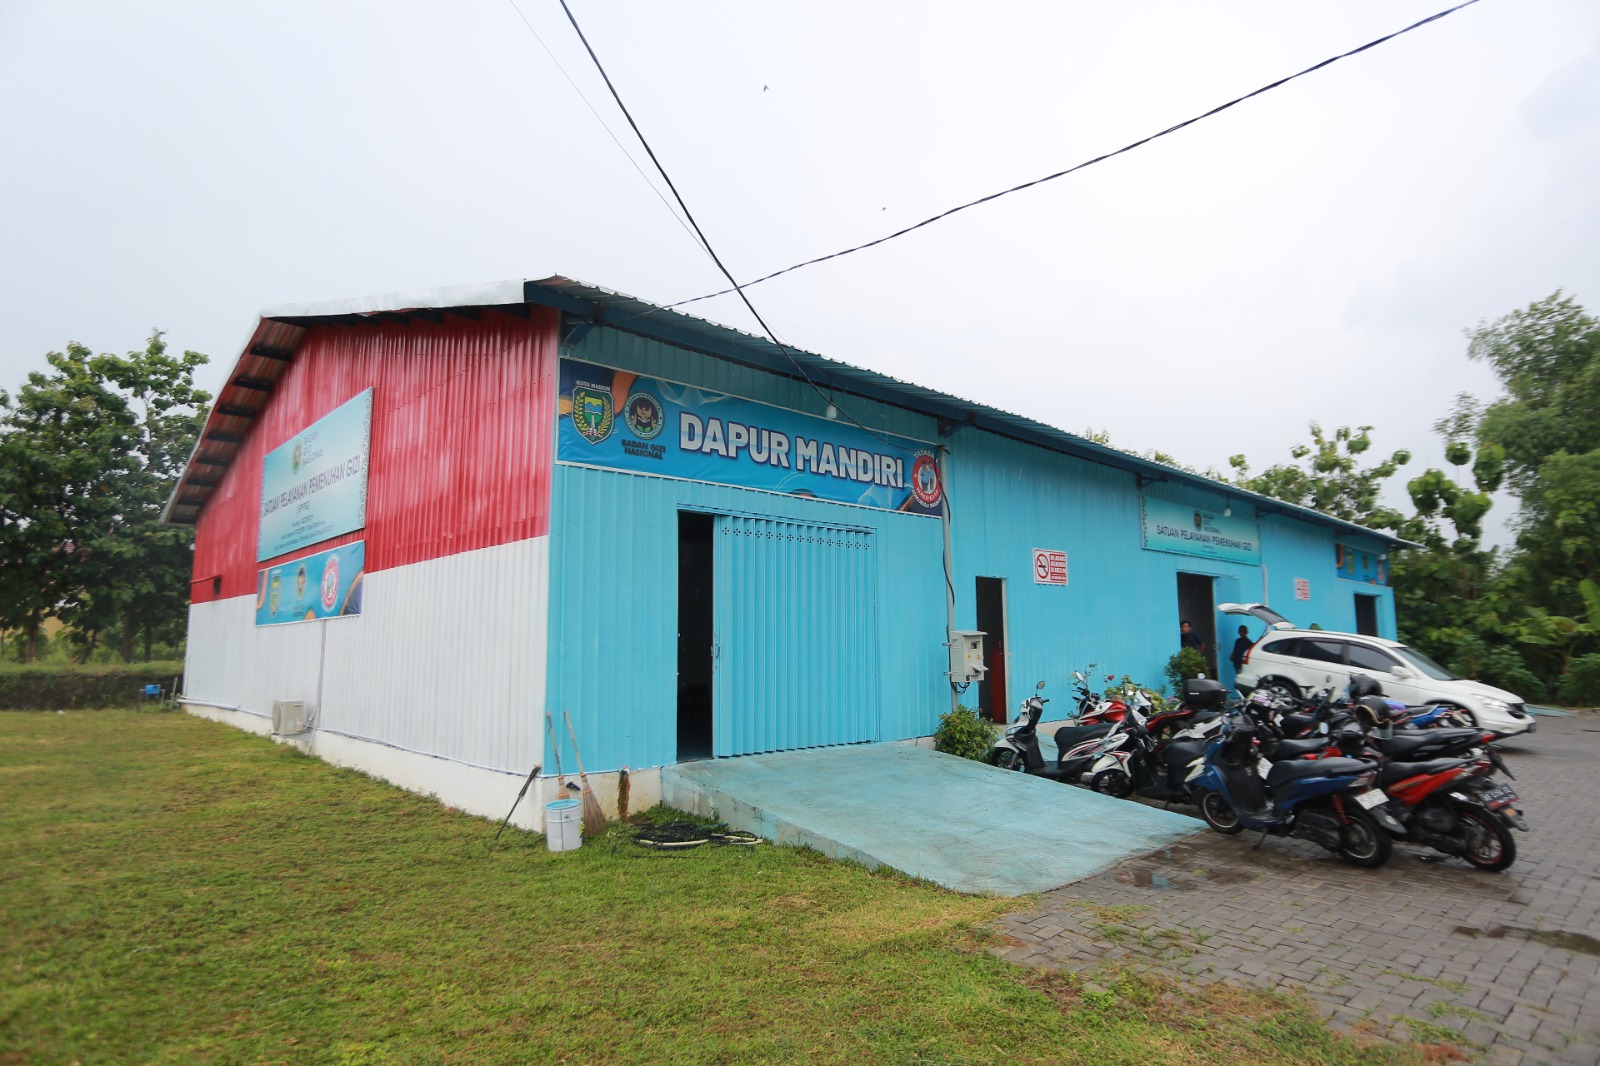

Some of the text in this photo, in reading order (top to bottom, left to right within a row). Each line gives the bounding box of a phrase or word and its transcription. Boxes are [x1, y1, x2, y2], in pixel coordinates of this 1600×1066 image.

[591, 383, 611, 391] MADIUN
[622, 439, 666, 453] BADAN GIZI
[625, 447, 663, 459] NASIONAL
[679, 411, 906, 490] DAPUR MANDIRI
[280, 481, 310, 508] PELAYANAN
[309, 461, 346, 494] PEMENUHAN
[346, 454, 361, 478] GIZI
[1156, 525, 1179, 538] SATUAN
[1180, 529, 1212, 543] PELAYANAN
[1212, 536, 1242, 549] PEMENUHAN
